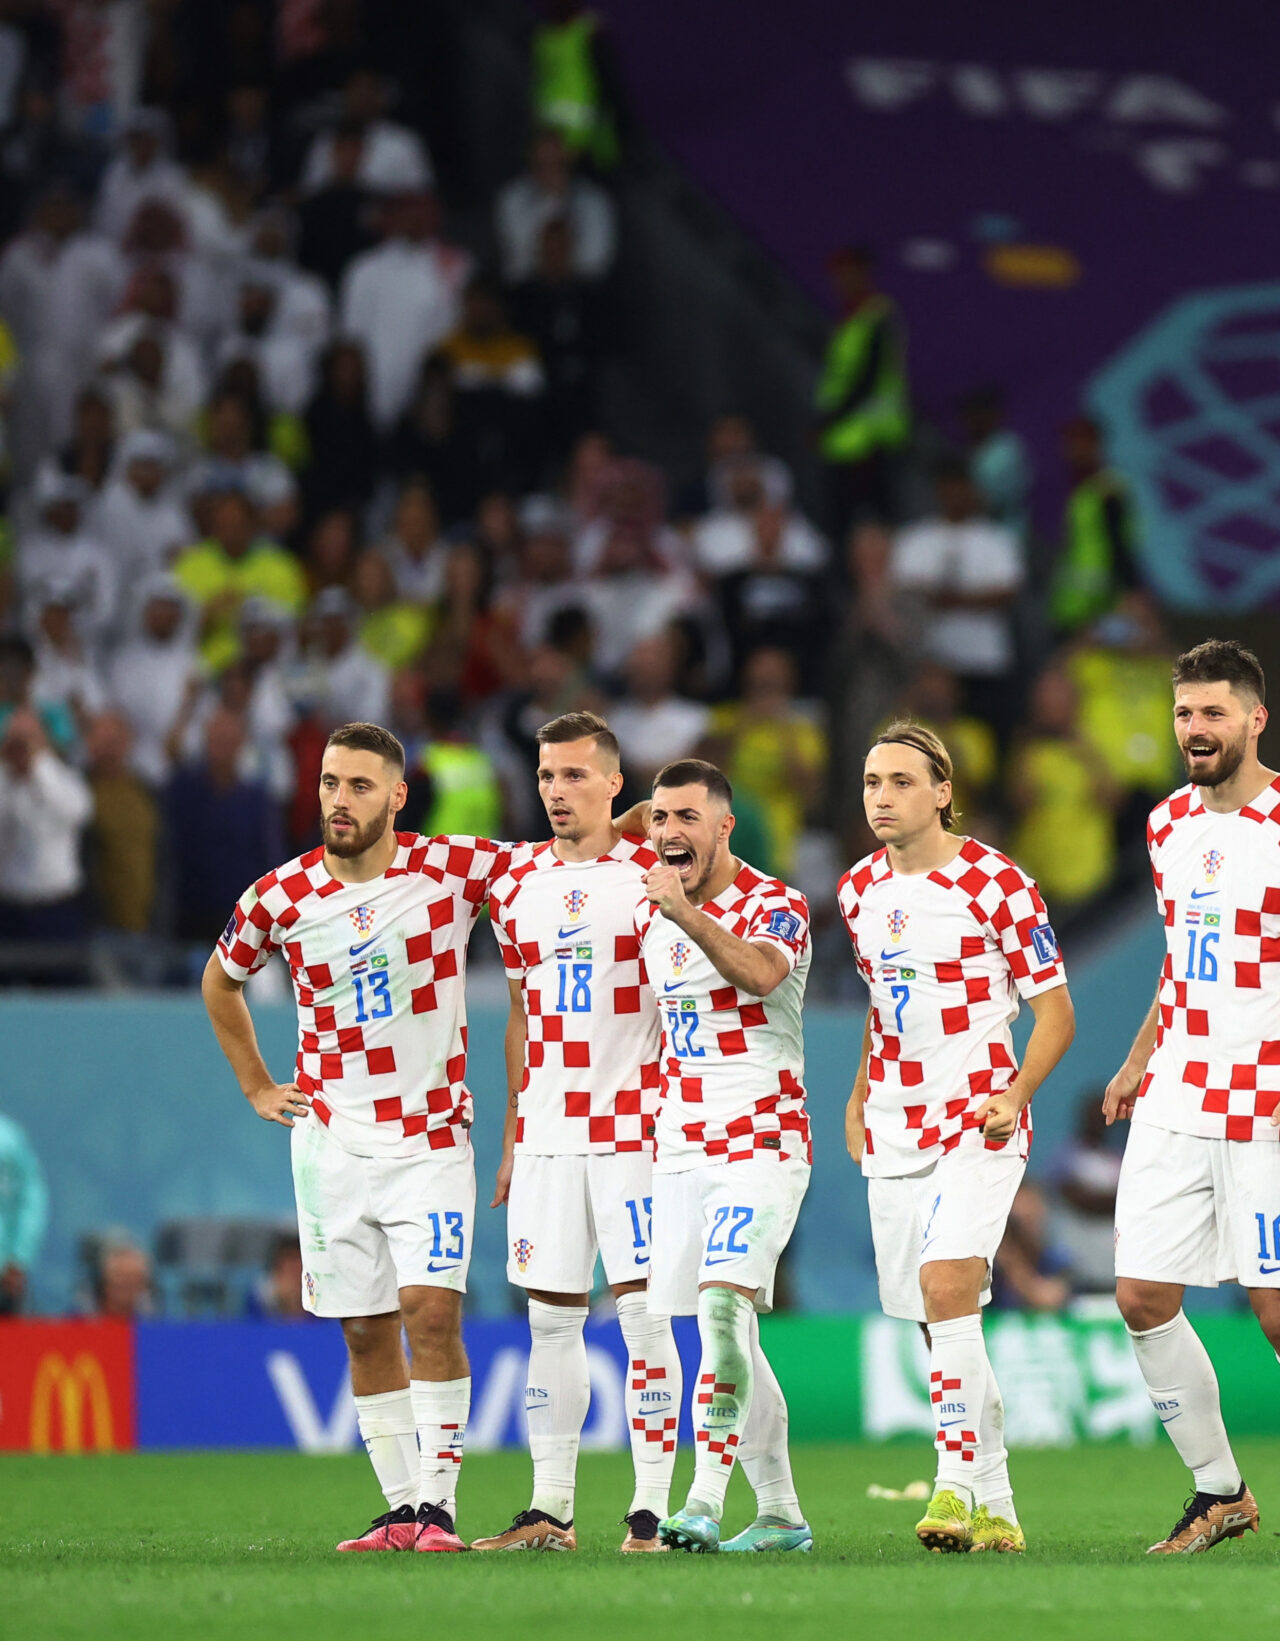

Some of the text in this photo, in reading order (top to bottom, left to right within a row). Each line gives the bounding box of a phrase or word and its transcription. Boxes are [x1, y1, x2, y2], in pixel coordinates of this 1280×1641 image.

[1185, 929, 1220, 982] 16
[351, 970, 393, 1023] 13
[556, 963, 593, 1013] 18
[891, 985, 910, 1033] 7
[667, 1012, 706, 1057] 22
[427, 1211, 464, 1260] 13
[706, 1206, 754, 1254] 22
